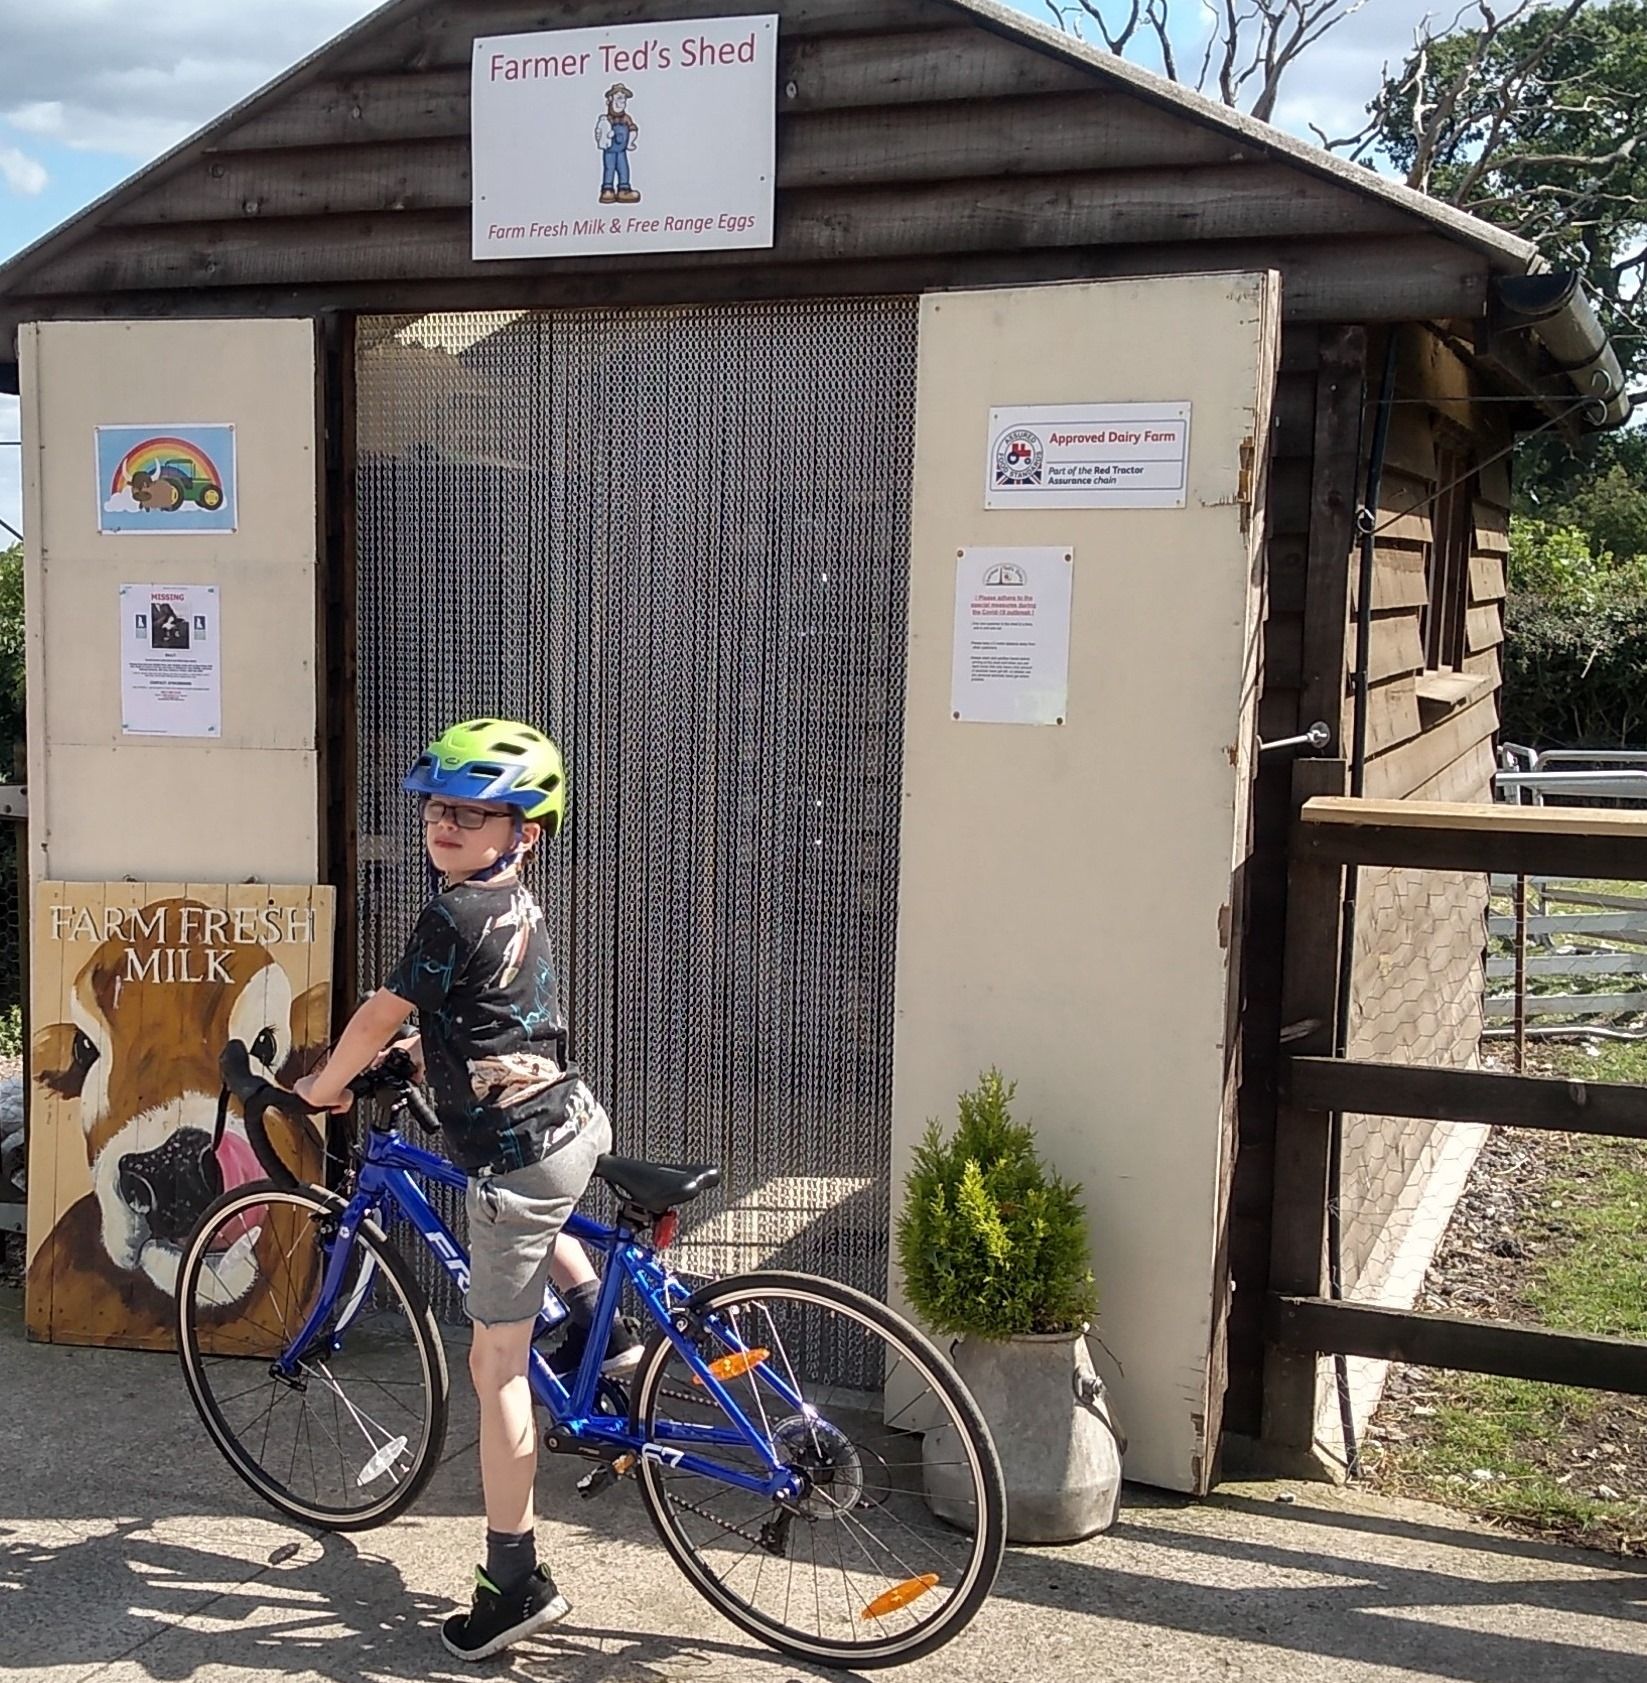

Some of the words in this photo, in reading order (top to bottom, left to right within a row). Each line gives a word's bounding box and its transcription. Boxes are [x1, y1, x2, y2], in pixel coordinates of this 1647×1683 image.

[490, 53, 591, 82] Farmer
[598, 39, 671, 73] Ted's
[680, 32, 756, 68] Shed
[488, 224, 525, 240] Farm
[529, 220, 568, 238] Fresh
[572, 218, 606, 236] Milk
[609, 219, 622, 234] &
[626, 217, 660, 233] Free
[663, 215, 714, 234] Range
[717, 213, 756, 232] Eggs
[1005, 431, 1036, 444] ASSURED
[1049, 431, 1105, 446] Approved
[1108, 431, 1141, 446] Dairy
[1144, 430, 1176, 442] Farm
[1048, 466, 1066, 475] Part
[1067, 466, 1077, 477] of
[1078, 466, 1092, 475] the
[1094, 466, 1111, 475] Red
[1112, 465, 1144, 474] Tractor
[1048, 476, 1092, 485] Assurance
[1093, 475, 1117, 484] chain
[151, 593, 185, 601] MISSING
[49, 905, 168, 944] FARM
[177, 905, 317, 945] FRESH
[123, 947, 236, 984] MILK
